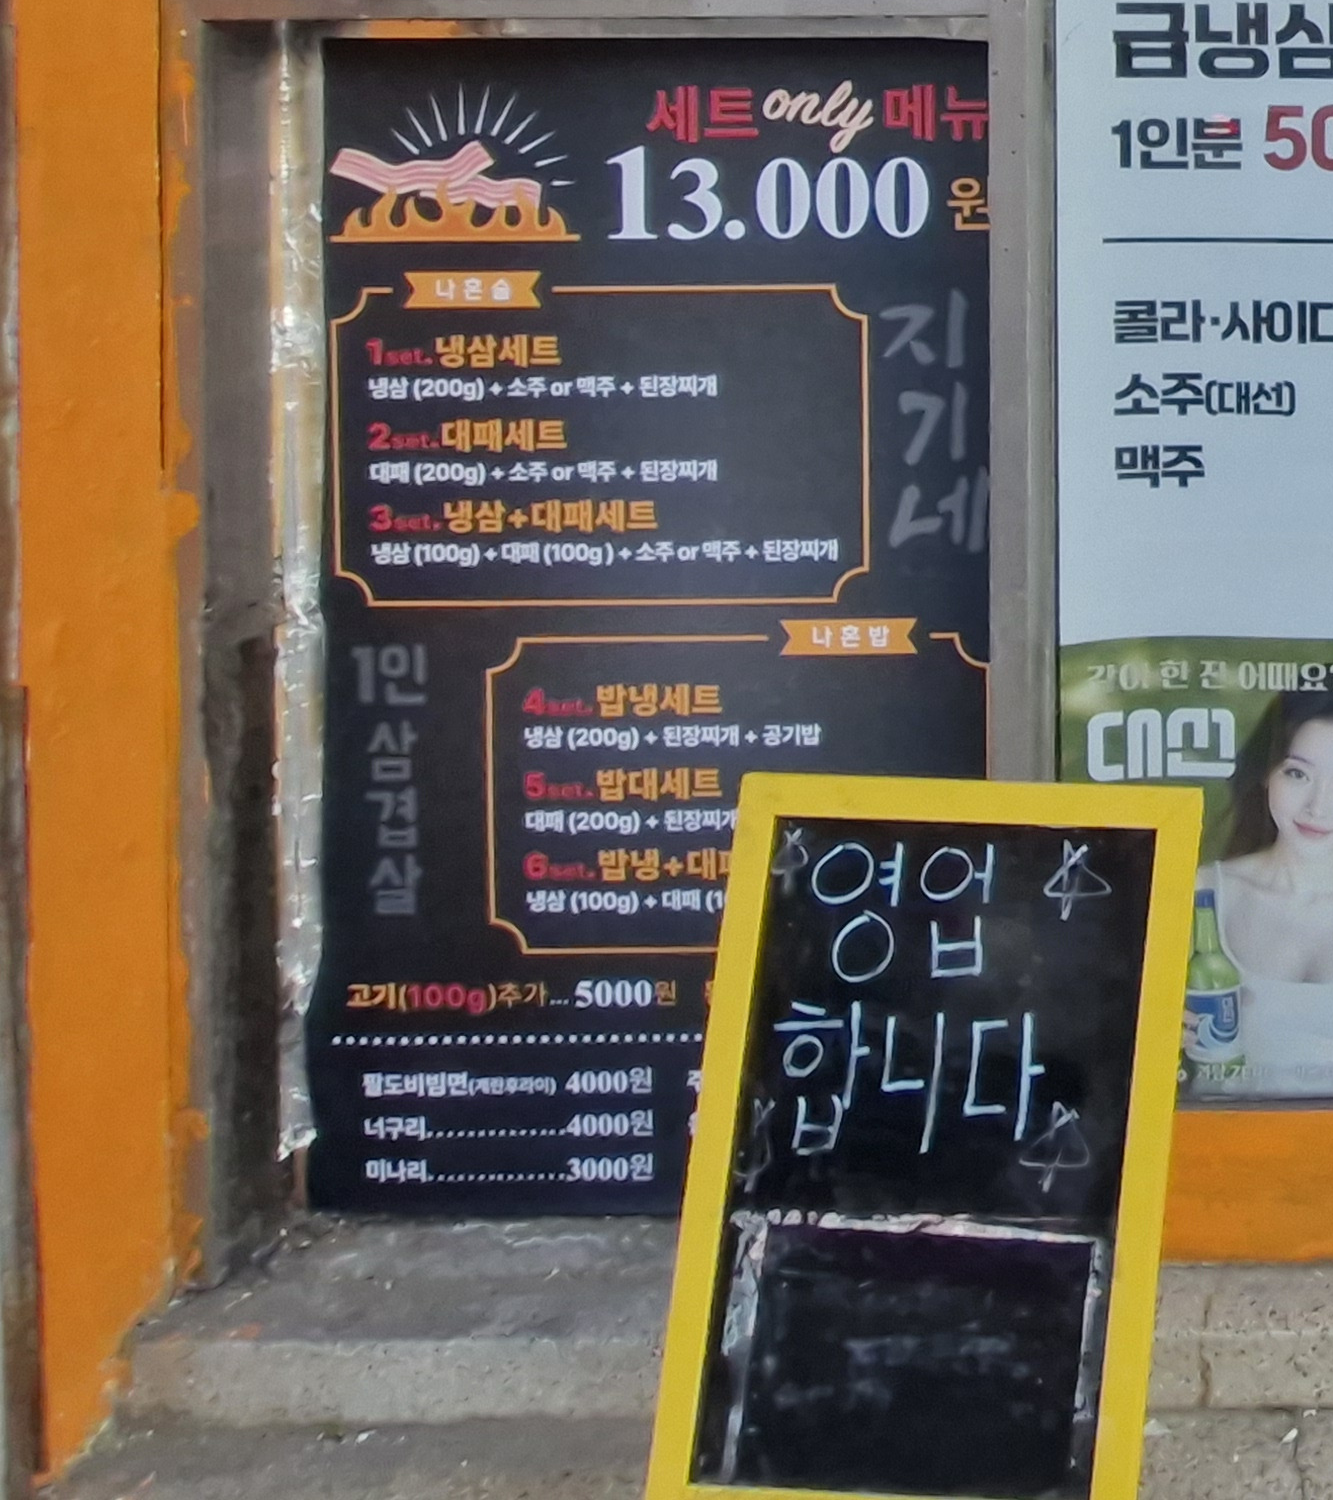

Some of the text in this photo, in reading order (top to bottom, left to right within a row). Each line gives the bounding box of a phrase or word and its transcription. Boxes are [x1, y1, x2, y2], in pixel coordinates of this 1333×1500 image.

[646, 80, 990, 153] 세트 only 메뉴
[1110, 117, 1244, 170] 1인분
[368, 376, 408, 400] 냉삼
[412, 376, 486, 402] (200g)
[507, 375, 547, 398] 소주
[550, 380, 573, 397] or
[576, 375, 616, 398] 맥주
[639, 374, 719, 398] 된장찌개
[441, 417, 568, 452] 대패세트
[368, 463, 409, 485] 대패
[413, 462, 486, 487] (200g)
[508, 461, 548, 484] 소주
[551, 465, 574, 482] or
[577, 460, 617, 483] 맥주
[639, 459, 719, 483] 된장찌개
[1114, 444, 1206, 488] 맥주
[370, 542, 411, 566] 냉삼
[414, 542, 480, 568] (100g)
[501, 542, 540, 564] 대패
[635, 541, 675, 563] 소주
[678, 546, 699, 563] or
[702, 540, 741, 563] 맥주
[762, 539, 840, 563] 된장찌개
[1160, 659, 1191, 690] 한
[595, 683, 723, 719] 밥냉세트
[523, 726, 562, 749] 냉삼
[567, 727, 640, 751] (200g)
[662, 725, 740, 747] 된장찌개
[762, 723, 822, 747] 공기밥
[595, 767, 723, 802] 밥대세트
[524, 810, 563, 832] 대패
[568, 811, 641, 835] (200g)
[526, 891, 566, 913] 냉삼
[570, 890, 640, 915] (100g)
[661, 889, 701, 911] 대패
[811, 842, 995, 984] 영업
[565, 1066, 653, 1096] 4000원
[772, 1001, 1046, 1155] 합니다
[363, 1110, 654, 1141] 너구리 4000원
[364, 1153, 654, 1183] 미나리 3000원
